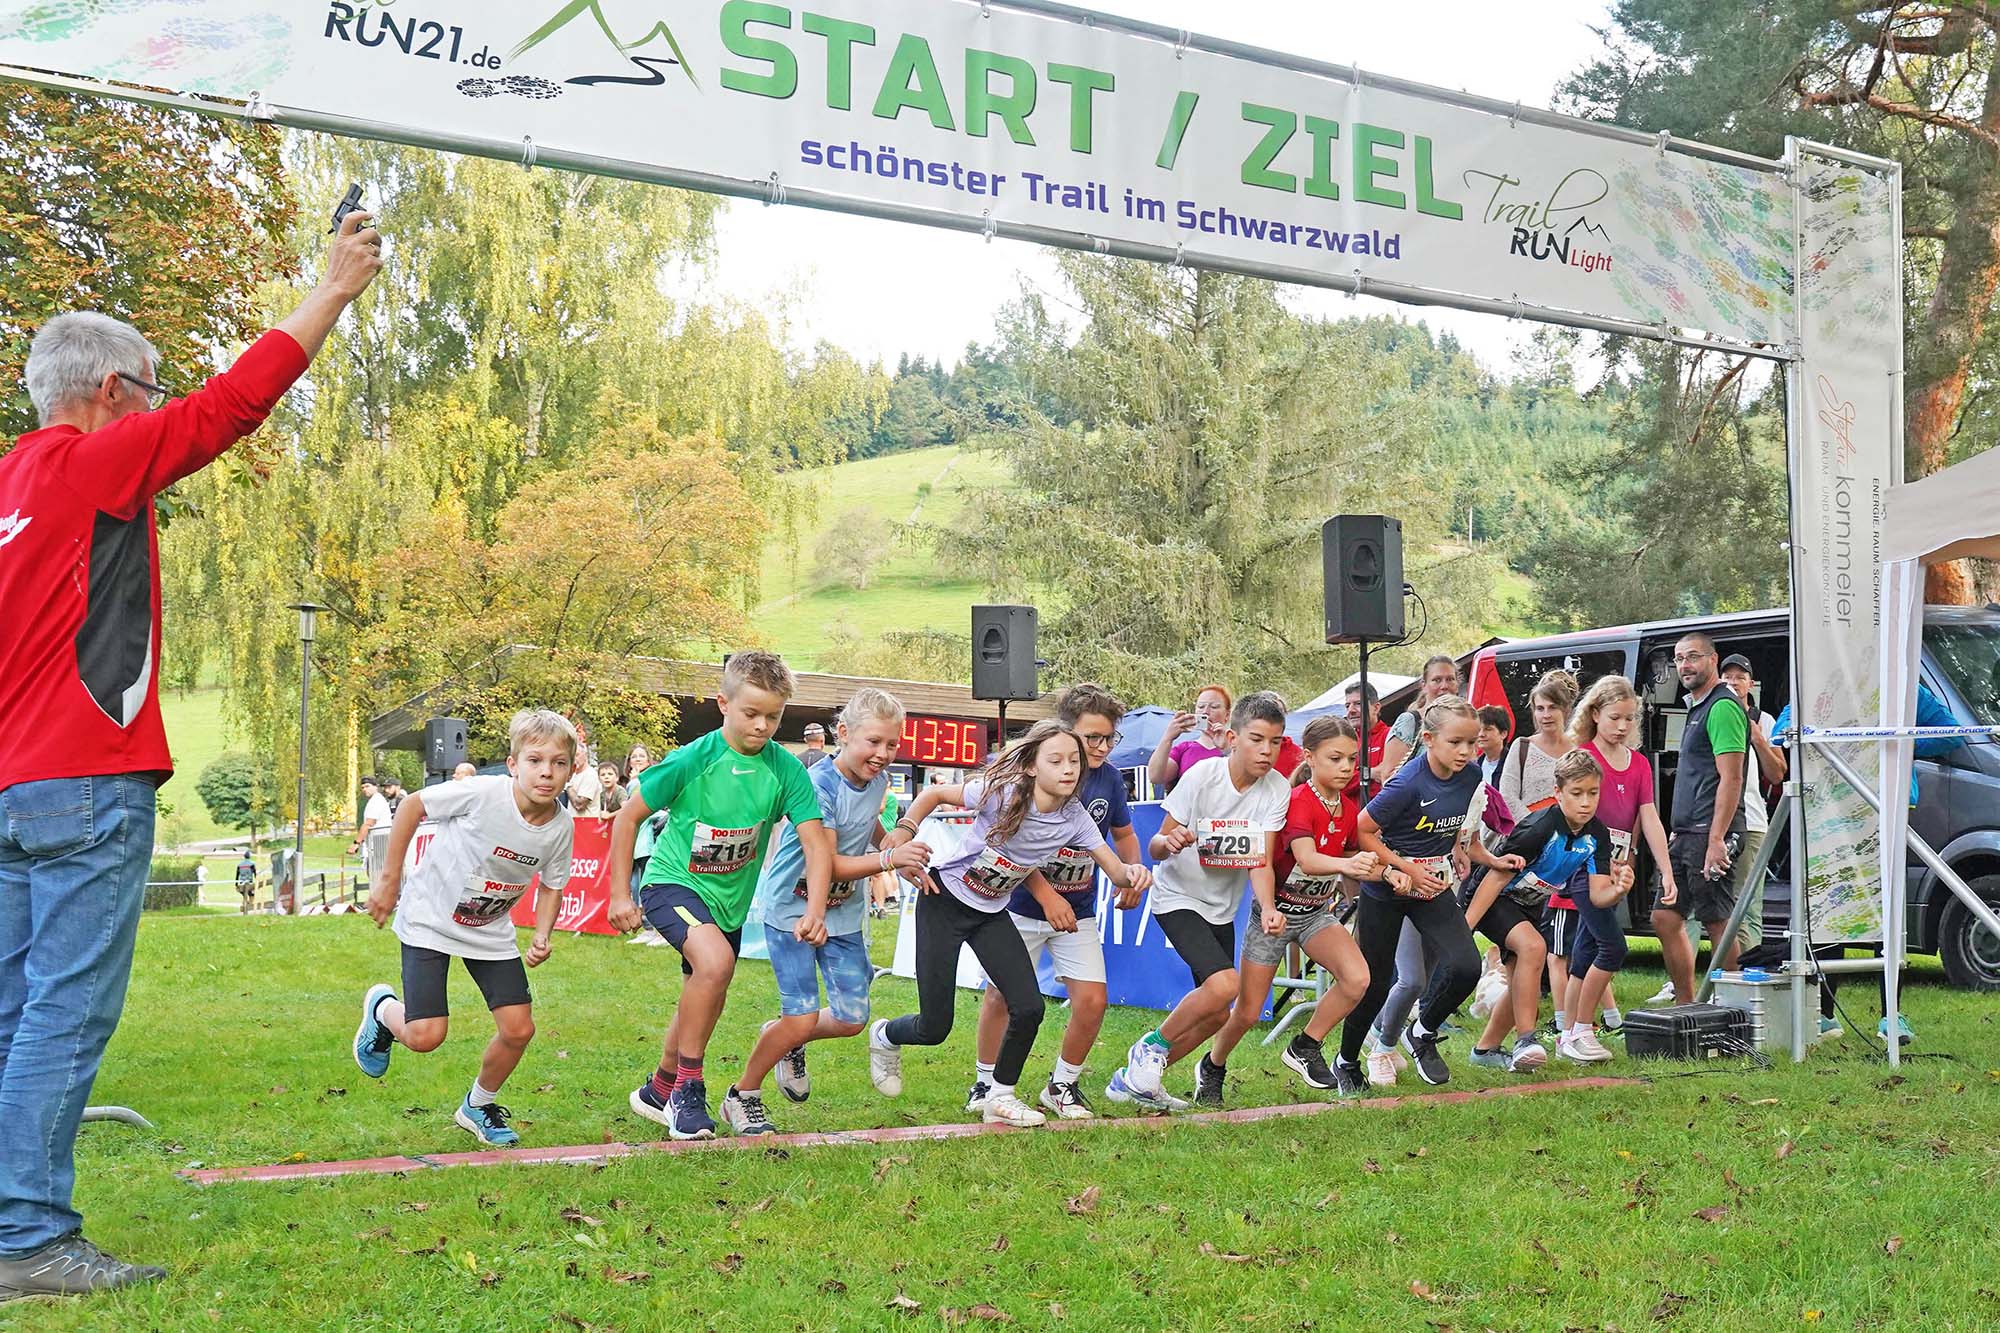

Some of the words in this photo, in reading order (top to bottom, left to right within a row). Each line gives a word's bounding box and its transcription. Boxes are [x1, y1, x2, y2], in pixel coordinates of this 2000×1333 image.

[325, 1, 501, 70] RUN21.de
[720, 0, 1115, 154] START
[1155, 91, 1199, 171] /
[1241, 102, 1463, 220] ZIEL
[801, 138, 1006, 197] schönster
[1022, 171, 1109, 214] Trail
[1125, 188, 1166, 222] im
[1177, 200, 1401, 260] Schwarzwald
[1463, 168, 1609, 240] Trail
[1510, 227, 1570, 264] RUN
[1570, 249, 1613, 273] Light
[1835, 476, 1856, 628] kornmeier
[710, 829, 729, 840] 100
[1210, 820, 1227, 833] 100
[708, 841, 751, 861] 715
[1057, 848, 1073, 858] 100
[1212, 836, 1251, 856] 729
[495, 848, 537, 864] pro-sort
[994, 856, 1012, 869] 100
[1204, 858, 1233, 866] TrailRUN
[1234, 857, 1261, 866] Schüler
[1053, 862, 1086, 881] 711
[1297, 879, 1332, 896] 730
